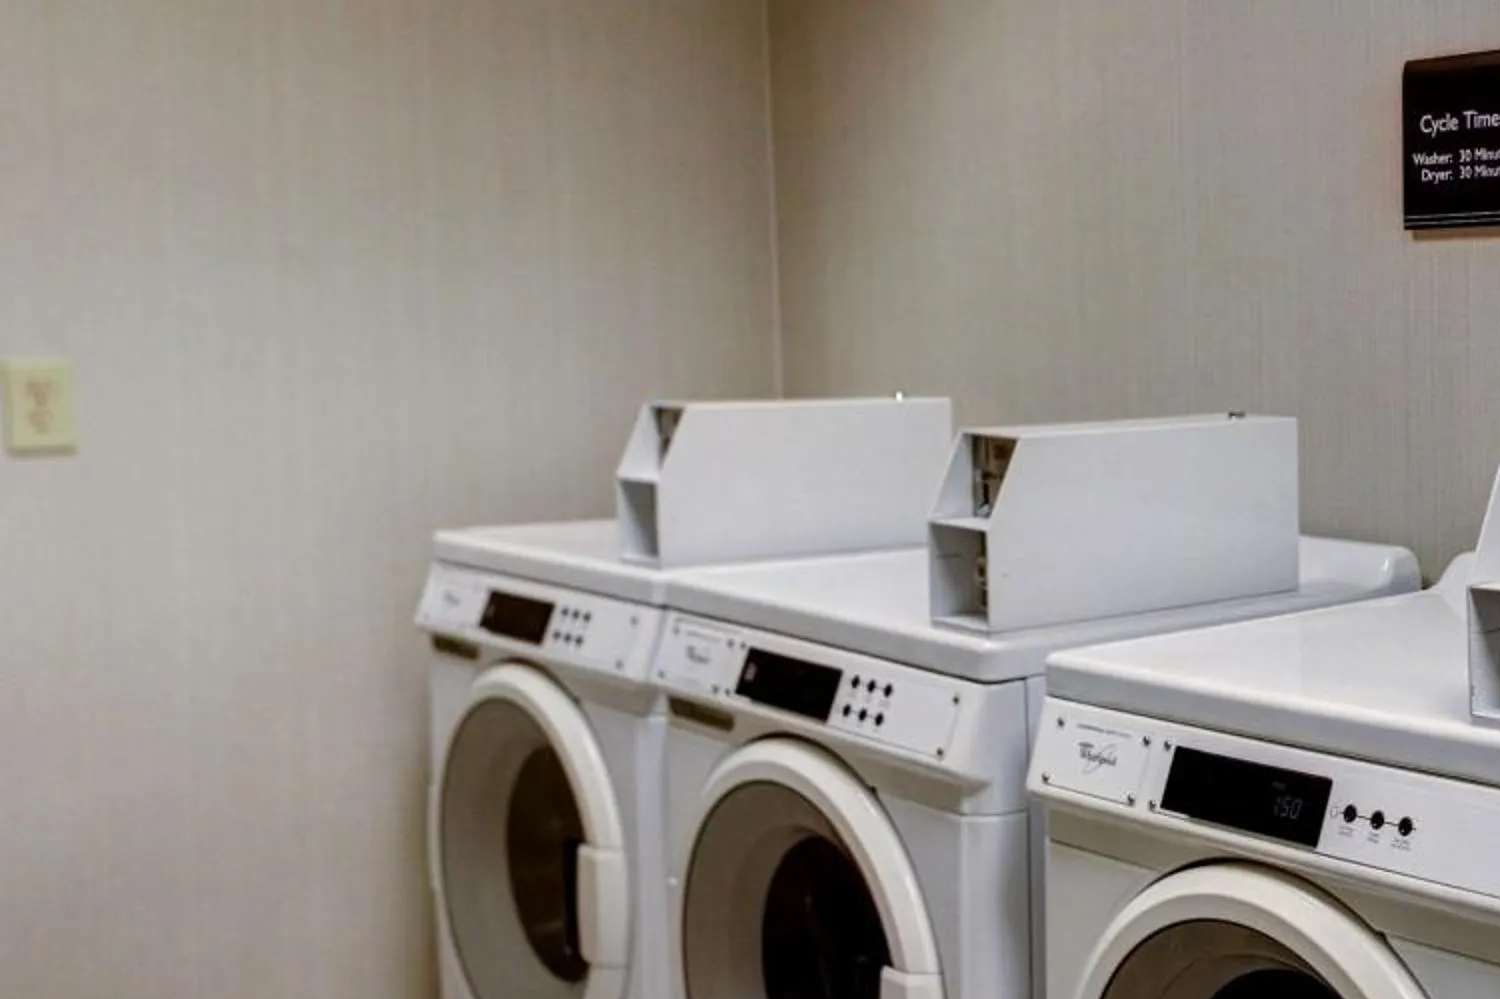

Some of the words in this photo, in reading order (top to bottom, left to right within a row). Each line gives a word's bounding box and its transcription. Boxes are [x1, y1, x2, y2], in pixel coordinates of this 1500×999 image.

[1419, 112, 1459, 139] Cycle
[1412, 152, 1453, 166] Washer:
[1459, 149, 1473, 163] 30
[1421, 169, 1453, 184] Dryer:
[1459, 165, 1473, 179] 30
